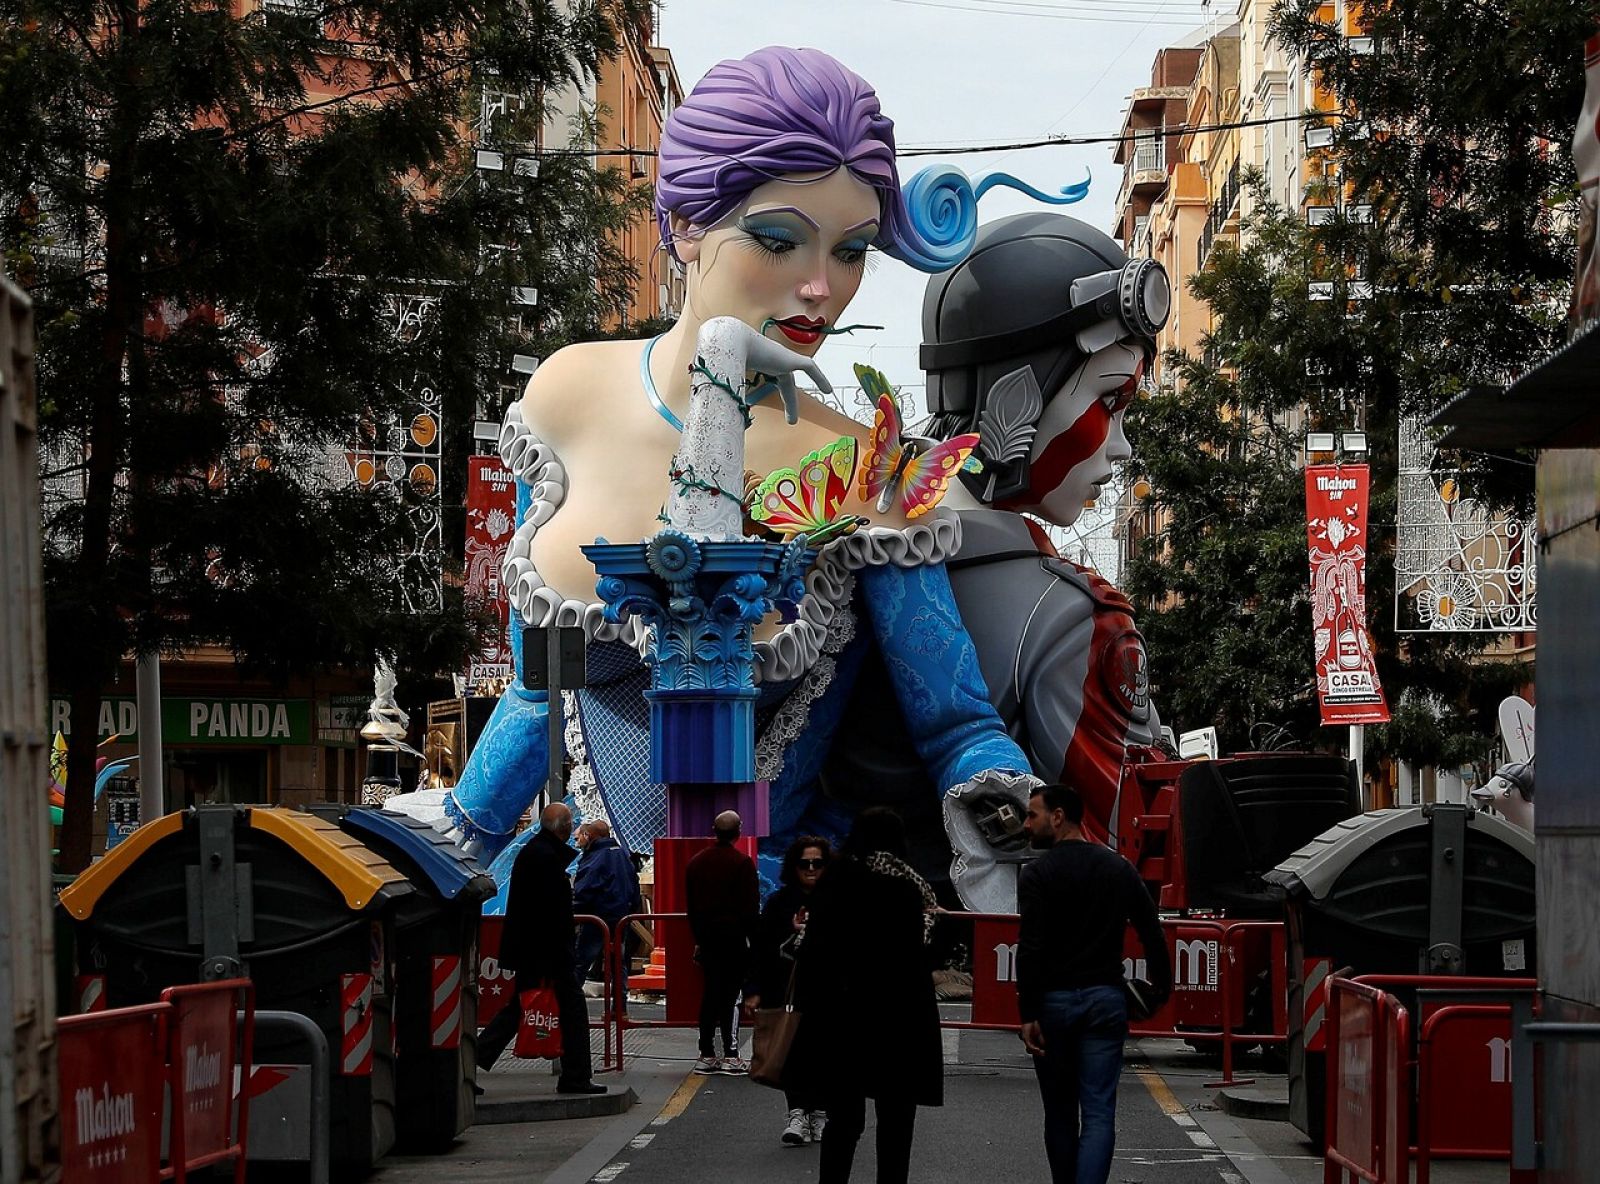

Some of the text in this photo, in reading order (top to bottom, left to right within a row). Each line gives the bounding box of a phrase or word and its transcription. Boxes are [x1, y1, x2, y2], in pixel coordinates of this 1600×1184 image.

[480, 467, 514, 483] Maho
[490, 482, 508, 493] SIN
[1316, 475, 1357, 491] Mahou
[190, 702, 291, 738] PANDA
[1208, 942, 1216, 984] montero
[185, 1039, 221, 1093] Mahou
[75, 1080, 136, 1146] Mahou
